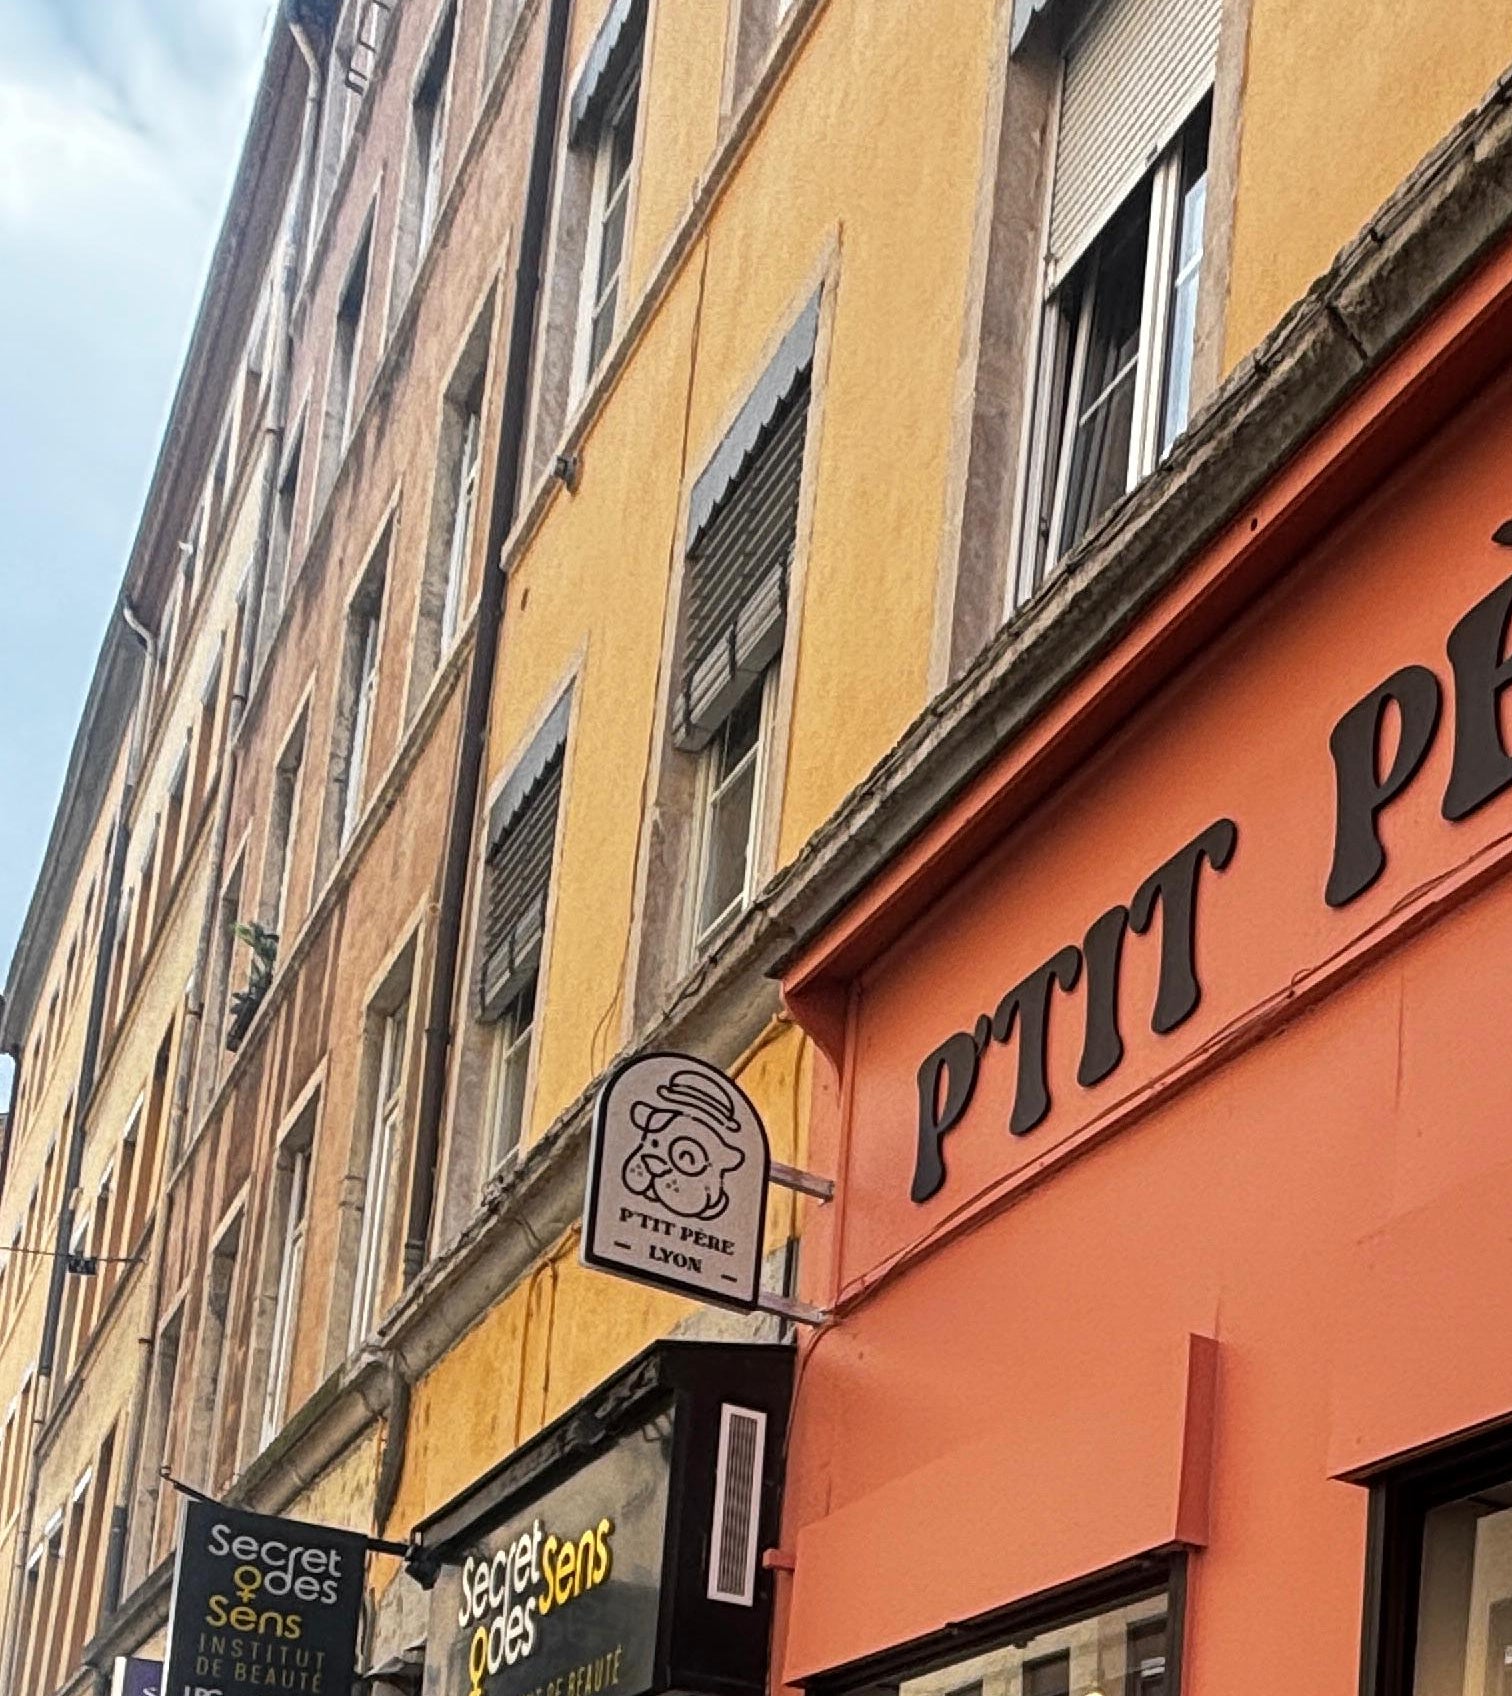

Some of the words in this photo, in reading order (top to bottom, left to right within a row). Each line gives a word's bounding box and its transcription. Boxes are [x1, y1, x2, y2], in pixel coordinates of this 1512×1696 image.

[910, 817, 1238, 1203] P'TIT
[619, 1207, 676, 1236] P'TIT
[680, 1227, 736, 1256] PÈRE
[648, 1245, 702, 1273] LYON
[208, 1524, 342, 1578] Secret
[264, 1568, 338, 1604] des
[205, 1594, 302, 1640] Sens
[487, 1597, 536, 1675] des
[199, 1633, 326, 1669] INSTITUT
[196, 1656, 225, 1679] DE
[235, 1661, 323, 1694] BEAUTÉ
